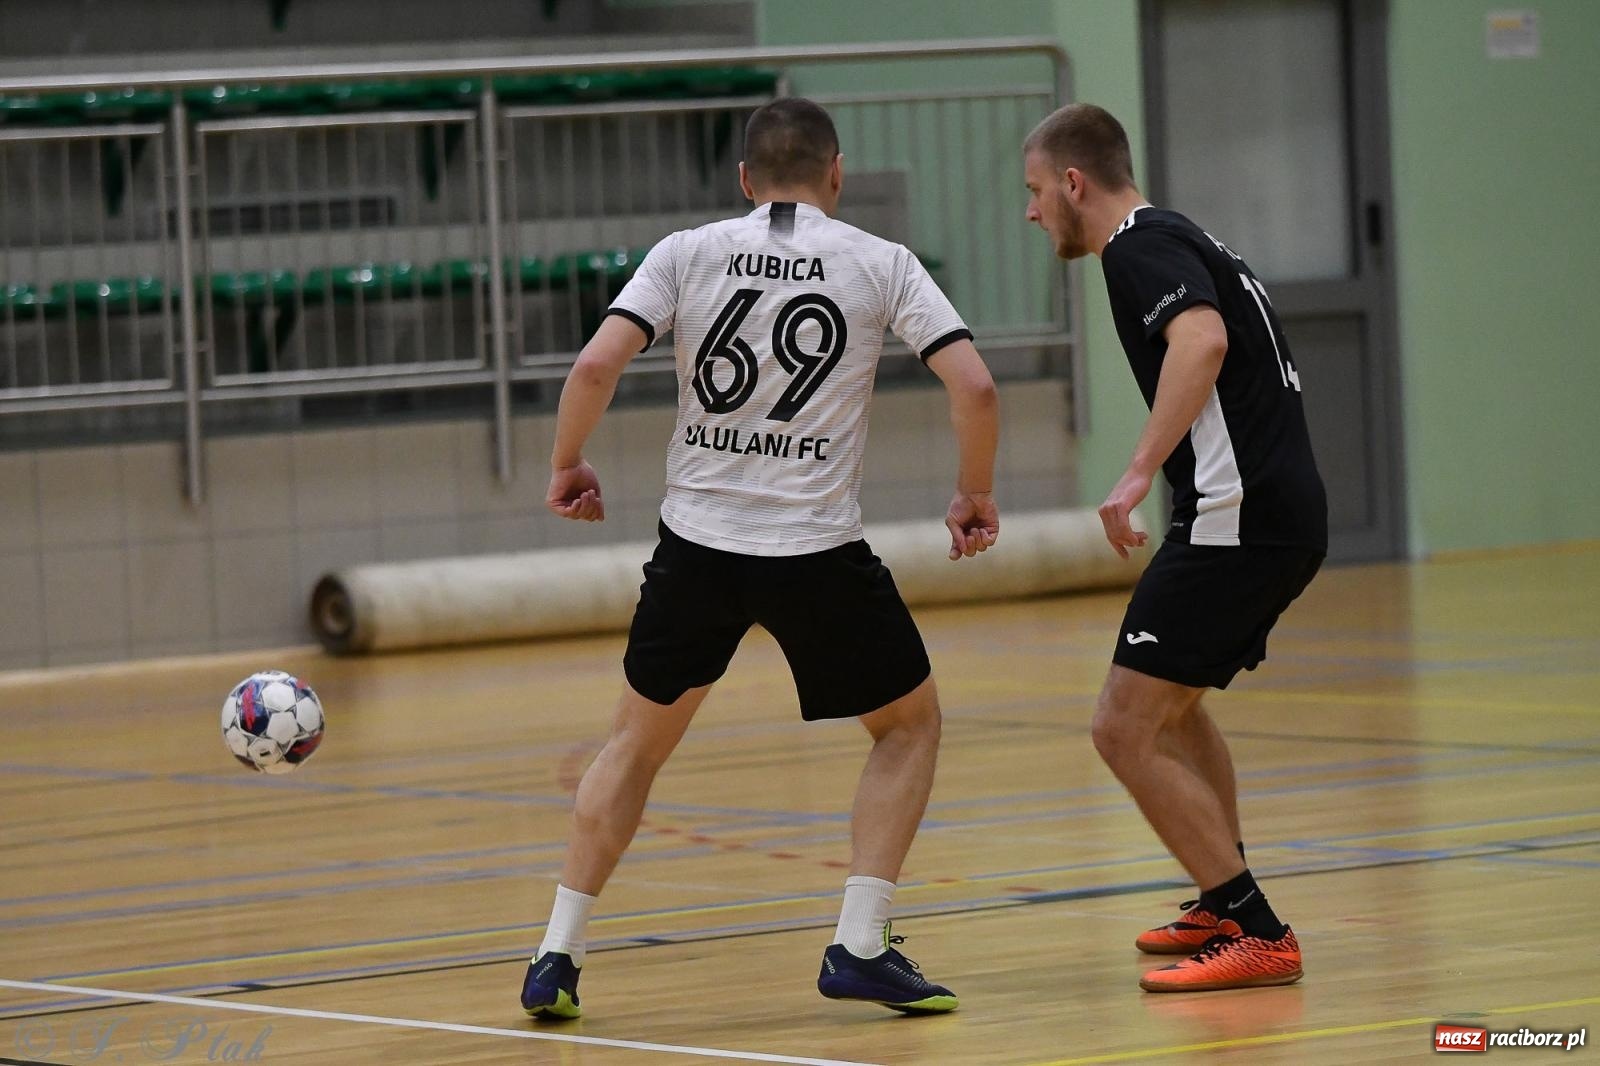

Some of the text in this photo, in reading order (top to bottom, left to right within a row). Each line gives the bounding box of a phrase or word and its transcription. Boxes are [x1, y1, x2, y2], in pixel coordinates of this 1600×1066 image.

[726, 253, 825, 281] KUBICA
[691, 288, 848, 422] 69
[684, 425, 830, 461] ULULANI FC
